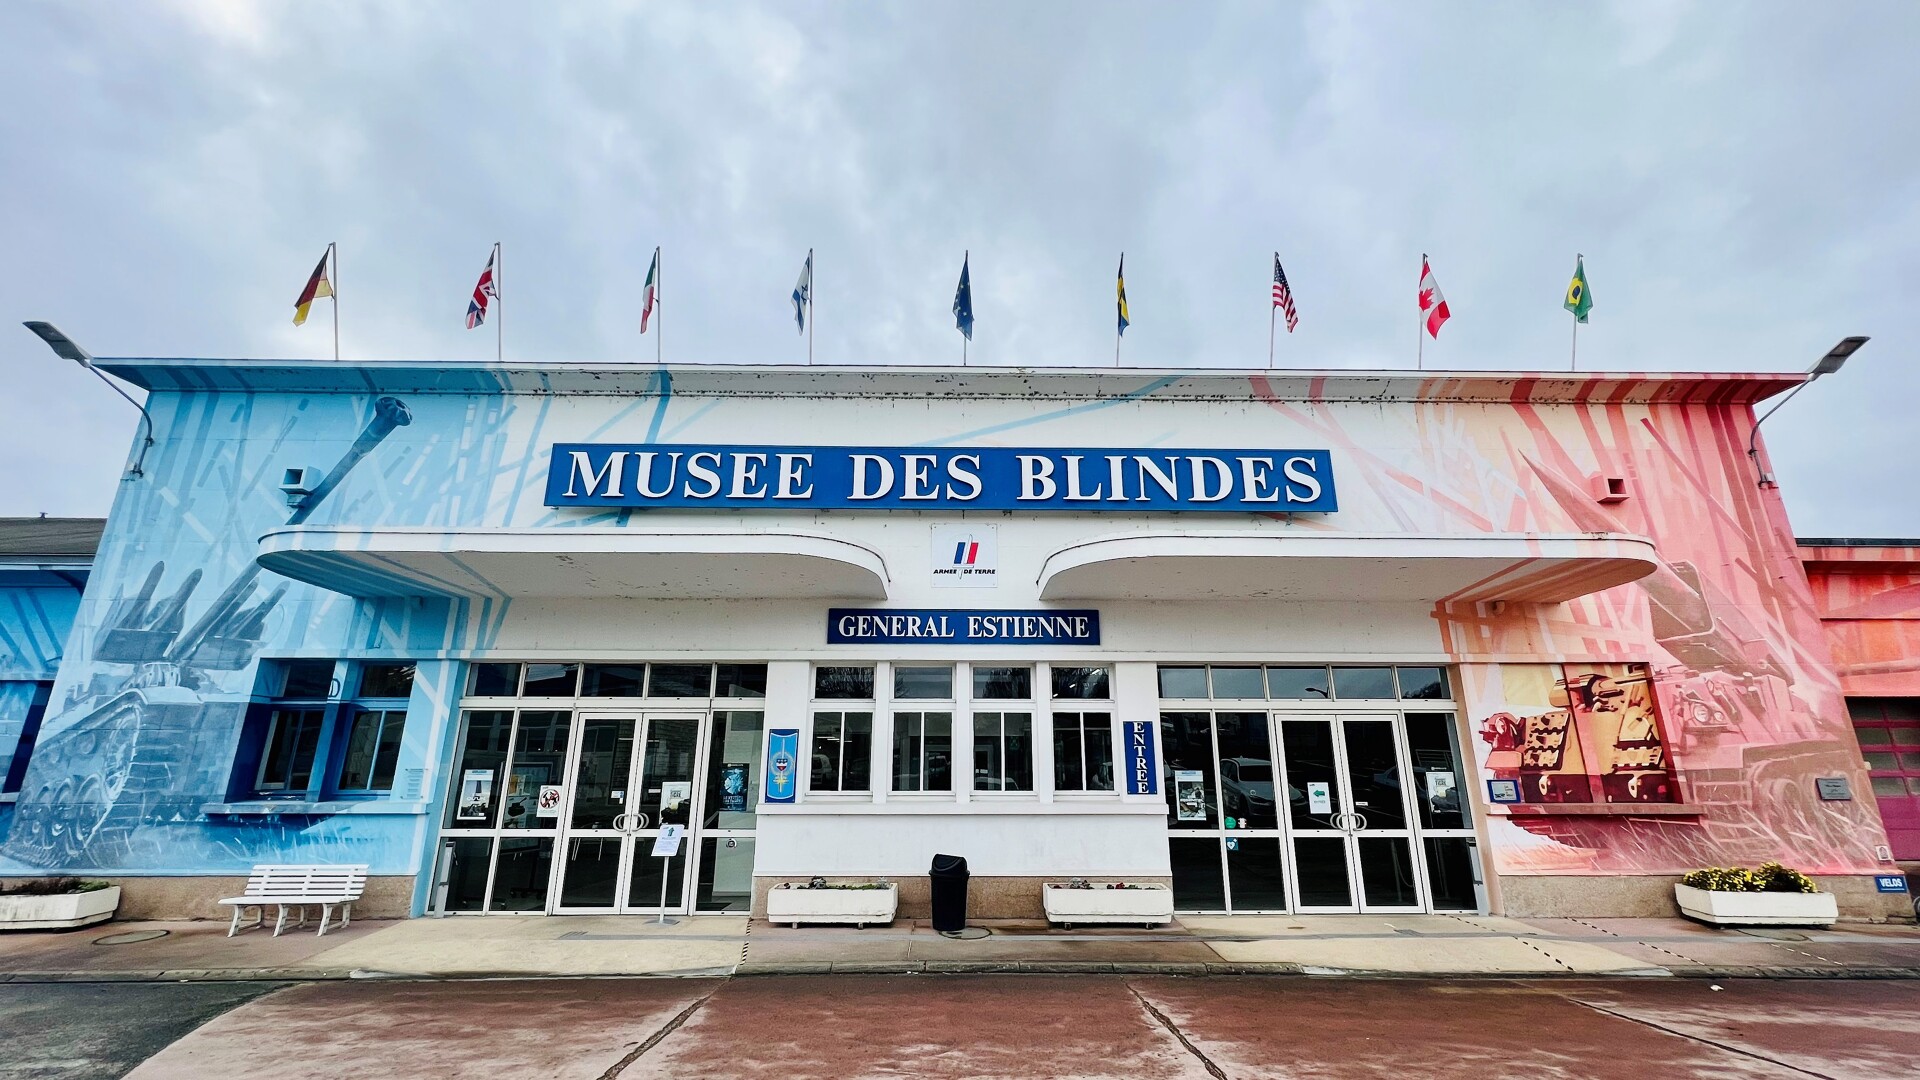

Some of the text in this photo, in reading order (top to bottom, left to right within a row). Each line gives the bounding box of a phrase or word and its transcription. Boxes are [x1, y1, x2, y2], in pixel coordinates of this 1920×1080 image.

[562, 451, 1322, 503] MUSEE DES BLINDES
[838, 615, 1090, 639] GENERAL ESTIENNE
[1132, 721, 1149, 794] ENTREE
[1879, 878, 1903, 888] VELOS
